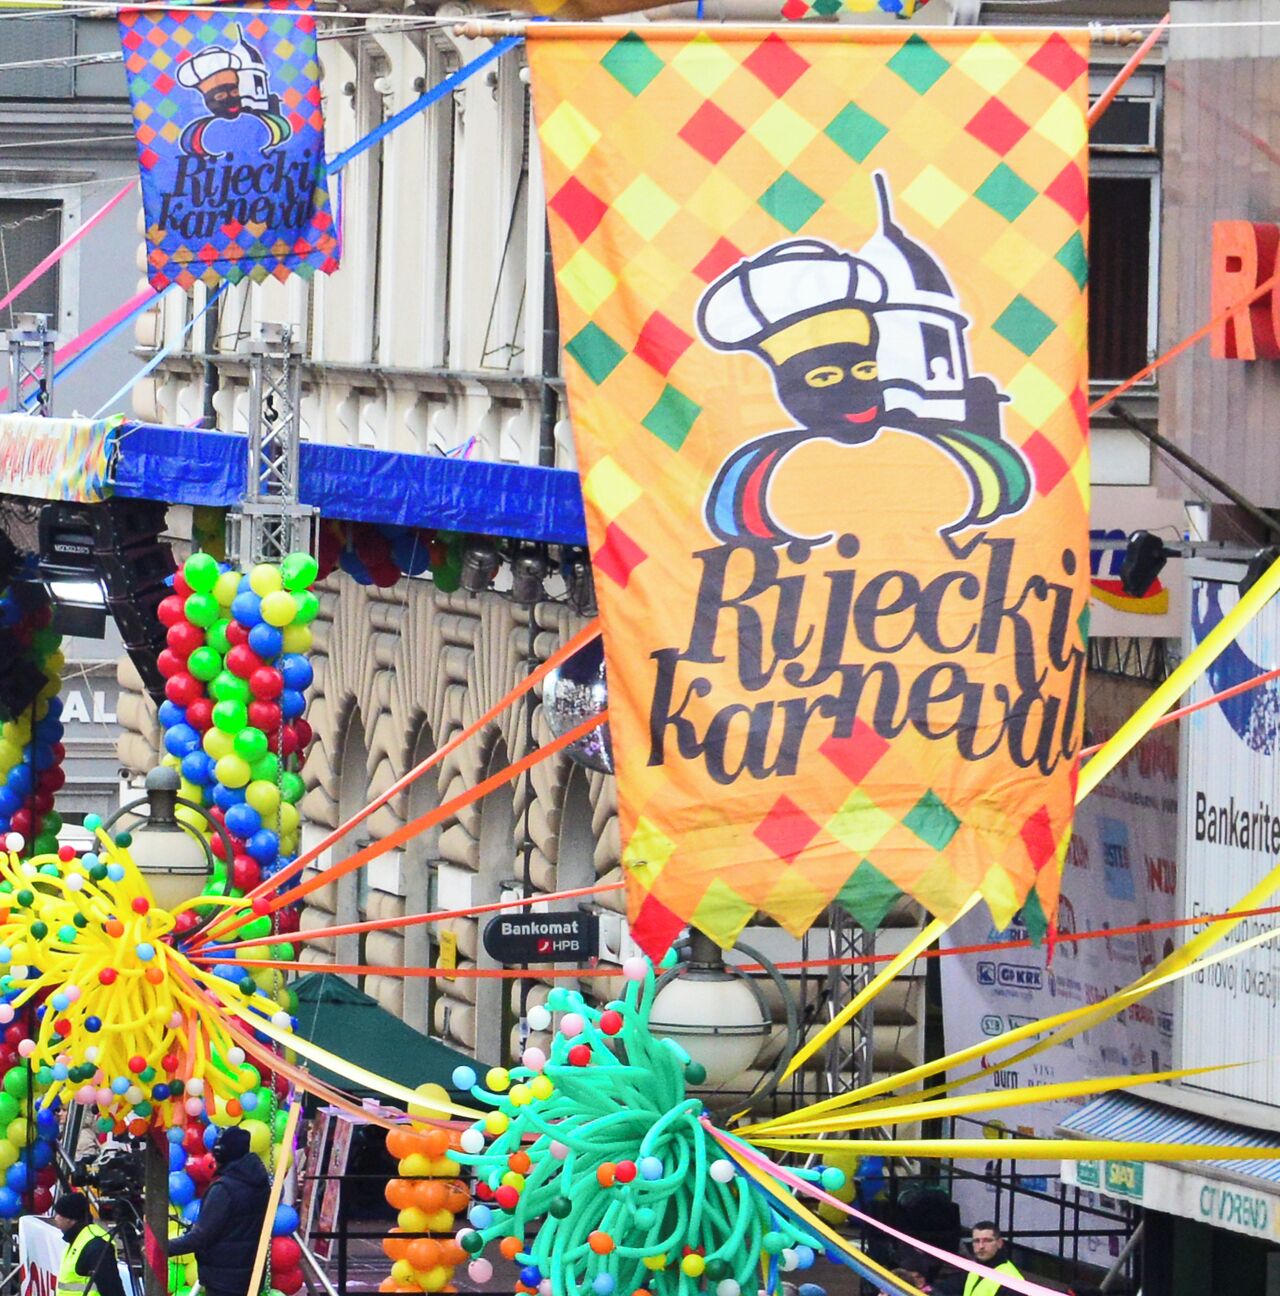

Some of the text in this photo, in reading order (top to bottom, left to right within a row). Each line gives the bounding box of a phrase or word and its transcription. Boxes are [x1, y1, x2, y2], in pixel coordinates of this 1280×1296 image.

[172, 148, 313, 207] Riječki
[158, 181, 317, 240] karneval
[680, 531, 1078, 691] Riječki
[646, 644, 1085, 785] karneval
[501, 921, 579, 936] Bankomat
[552, 940, 580, 951] HPB
